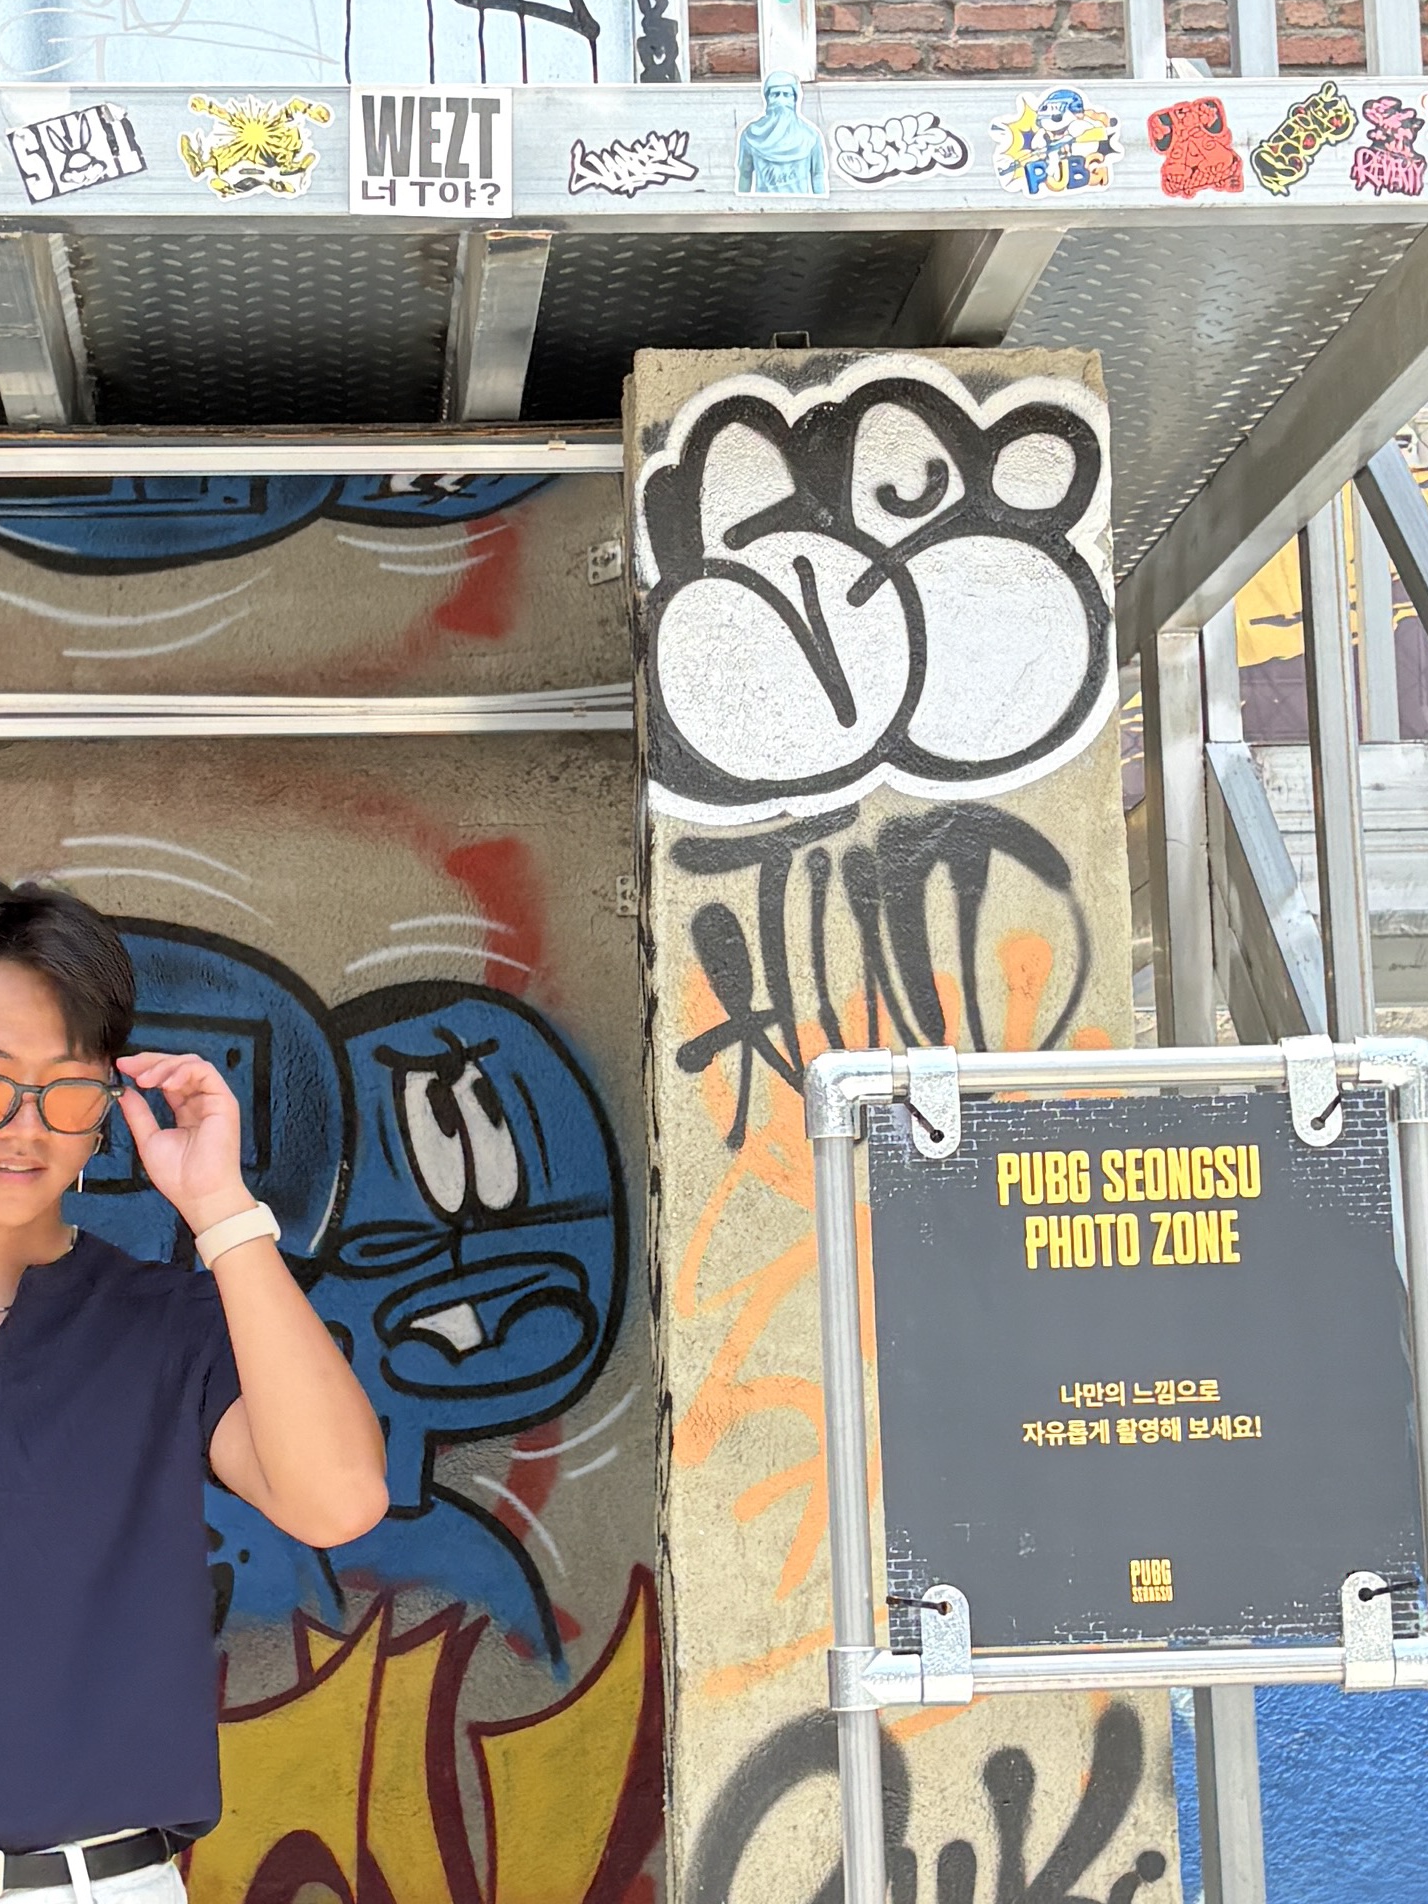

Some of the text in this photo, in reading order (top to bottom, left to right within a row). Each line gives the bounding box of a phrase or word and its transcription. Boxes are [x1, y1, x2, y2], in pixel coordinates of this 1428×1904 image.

[360, 95, 501, 180] WEZT
[361, 181, 398, 208] 너
[997, 1144, 1262, 1206] PUBG SEONGSU
[1025, 1210, 1241, 1269] PHOTO ZONE
[1060, 1379, 1221, 1409] 나만의 느낌으로
[1022, 1414, 1262, 1447] 자유롭게 촬영해 보세요!
[1129, 1558, 1172, 1587] PUBG
[1131, 1585, 1173, 1603] SEONGSU
